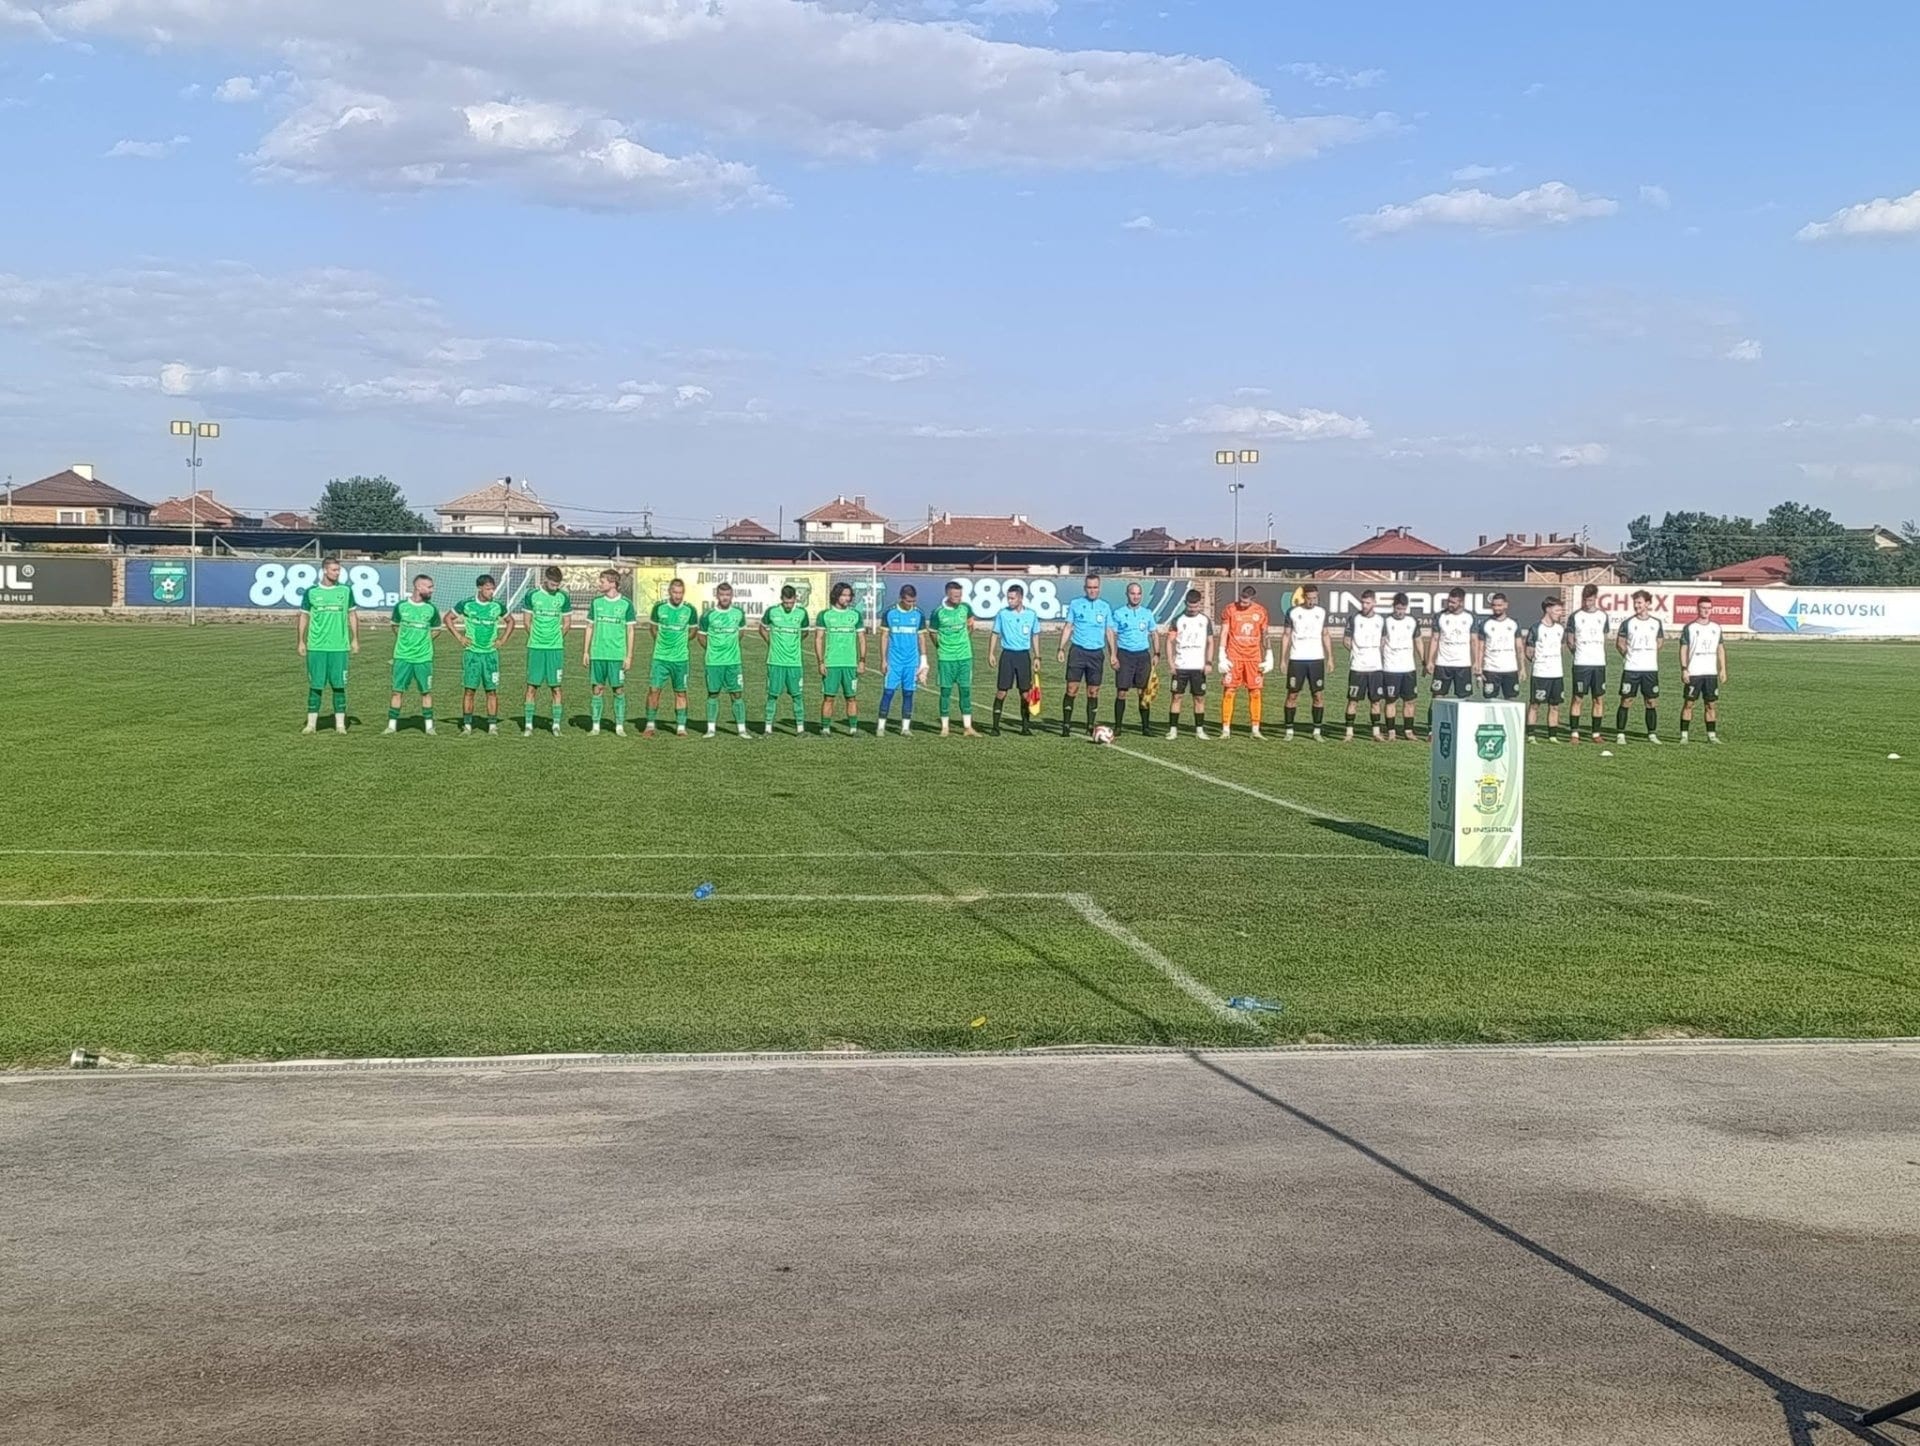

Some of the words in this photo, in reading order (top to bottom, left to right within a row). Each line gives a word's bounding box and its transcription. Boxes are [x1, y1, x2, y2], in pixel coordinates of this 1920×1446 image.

[697, 572, 729, 585] ДОБРЕ
[731, 572, 769, 585] ДОШЛИ
[1799, 603, 1886, 616] RAKOVSKI
[1535, 689, 1547, 701] 22
